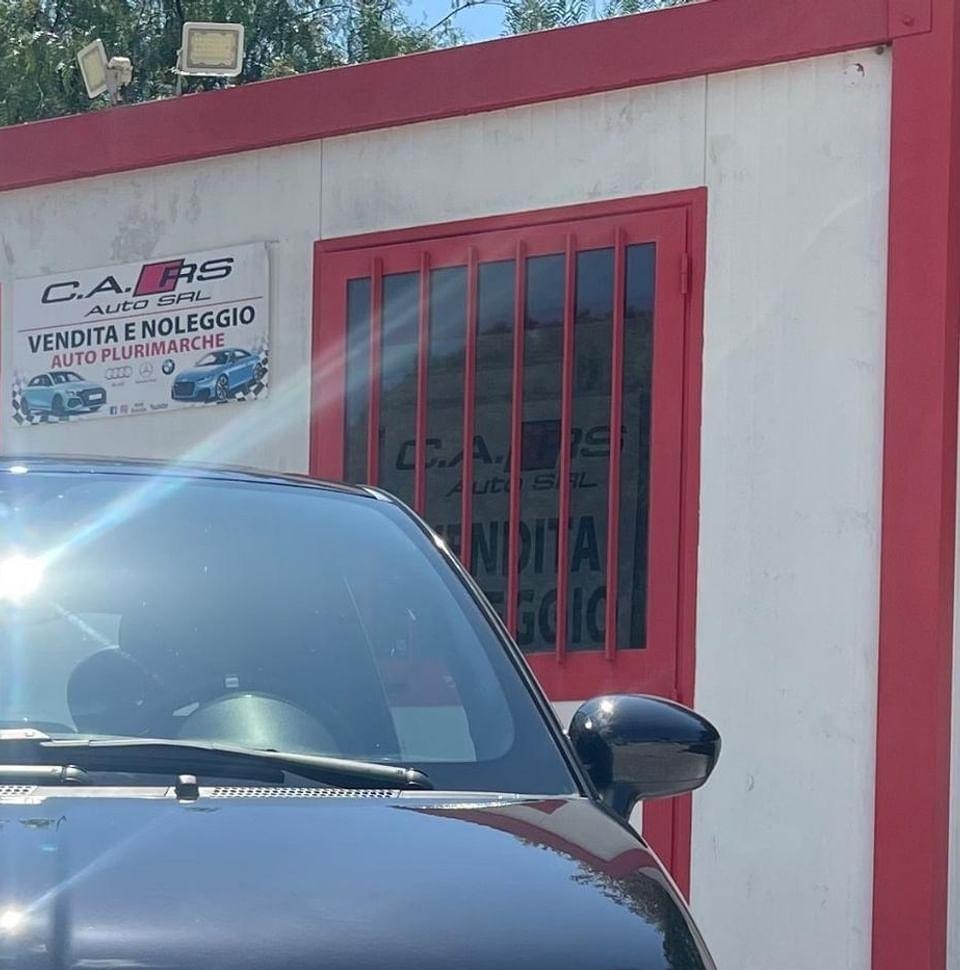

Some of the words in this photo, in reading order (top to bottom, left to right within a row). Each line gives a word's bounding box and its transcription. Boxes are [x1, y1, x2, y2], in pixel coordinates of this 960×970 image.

[85, 299, 148, 317] Auto
[156, 290, 211, 307] SRL
[28, 325, 116, 353] VENDITA
[125, 322, 136, 341] E
[142, 305, 256, 339] NOLEGGIO
[51, 351, 97, 369] AUTO
[102, 333, 225, 362] PLURIMARCHE
[433, 515, 601, 577] ENDITA
